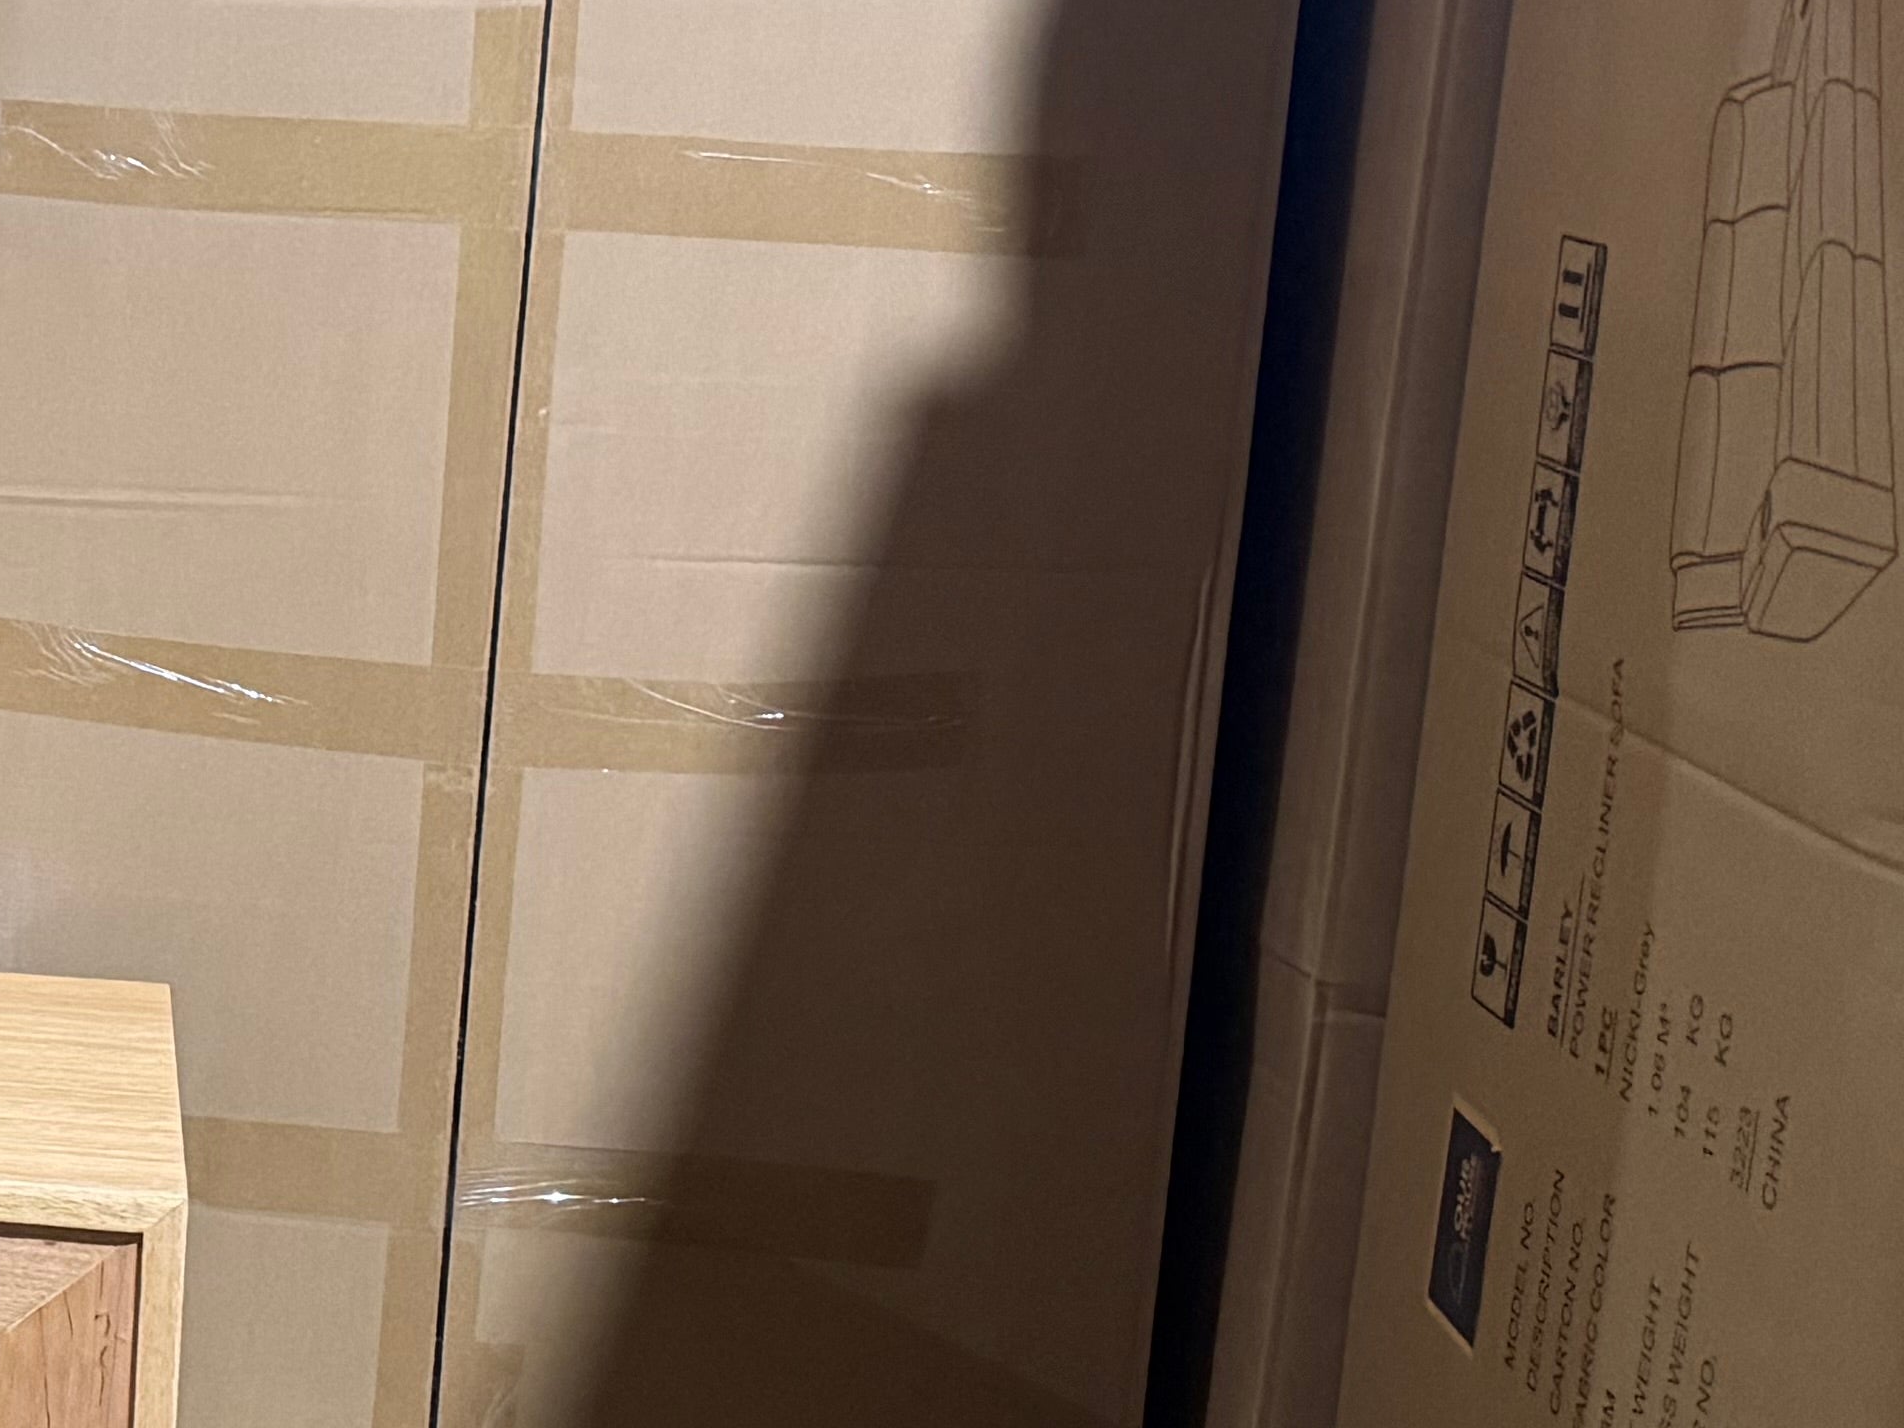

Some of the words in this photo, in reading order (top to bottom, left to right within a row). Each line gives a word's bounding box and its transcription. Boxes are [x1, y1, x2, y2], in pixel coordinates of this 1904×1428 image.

[1547, 898, 1573, 1038] BARLEY
[1686, 993, 1704, 1047] KG
[1715, 1012, 1733, 1068] KG
[1762, 1094, 1790, 1211] CHINA
[1504, 1258, 1529, 1371] MODEL
[1527, 1169, 1565, 1393] DESCRIPTION
[1550, 1276, 1577, 1416] CARTON
[1632, 1274, 1663, 1415] WEIGHT
[1667, 1239, 1701, 1387] WEIGHT
